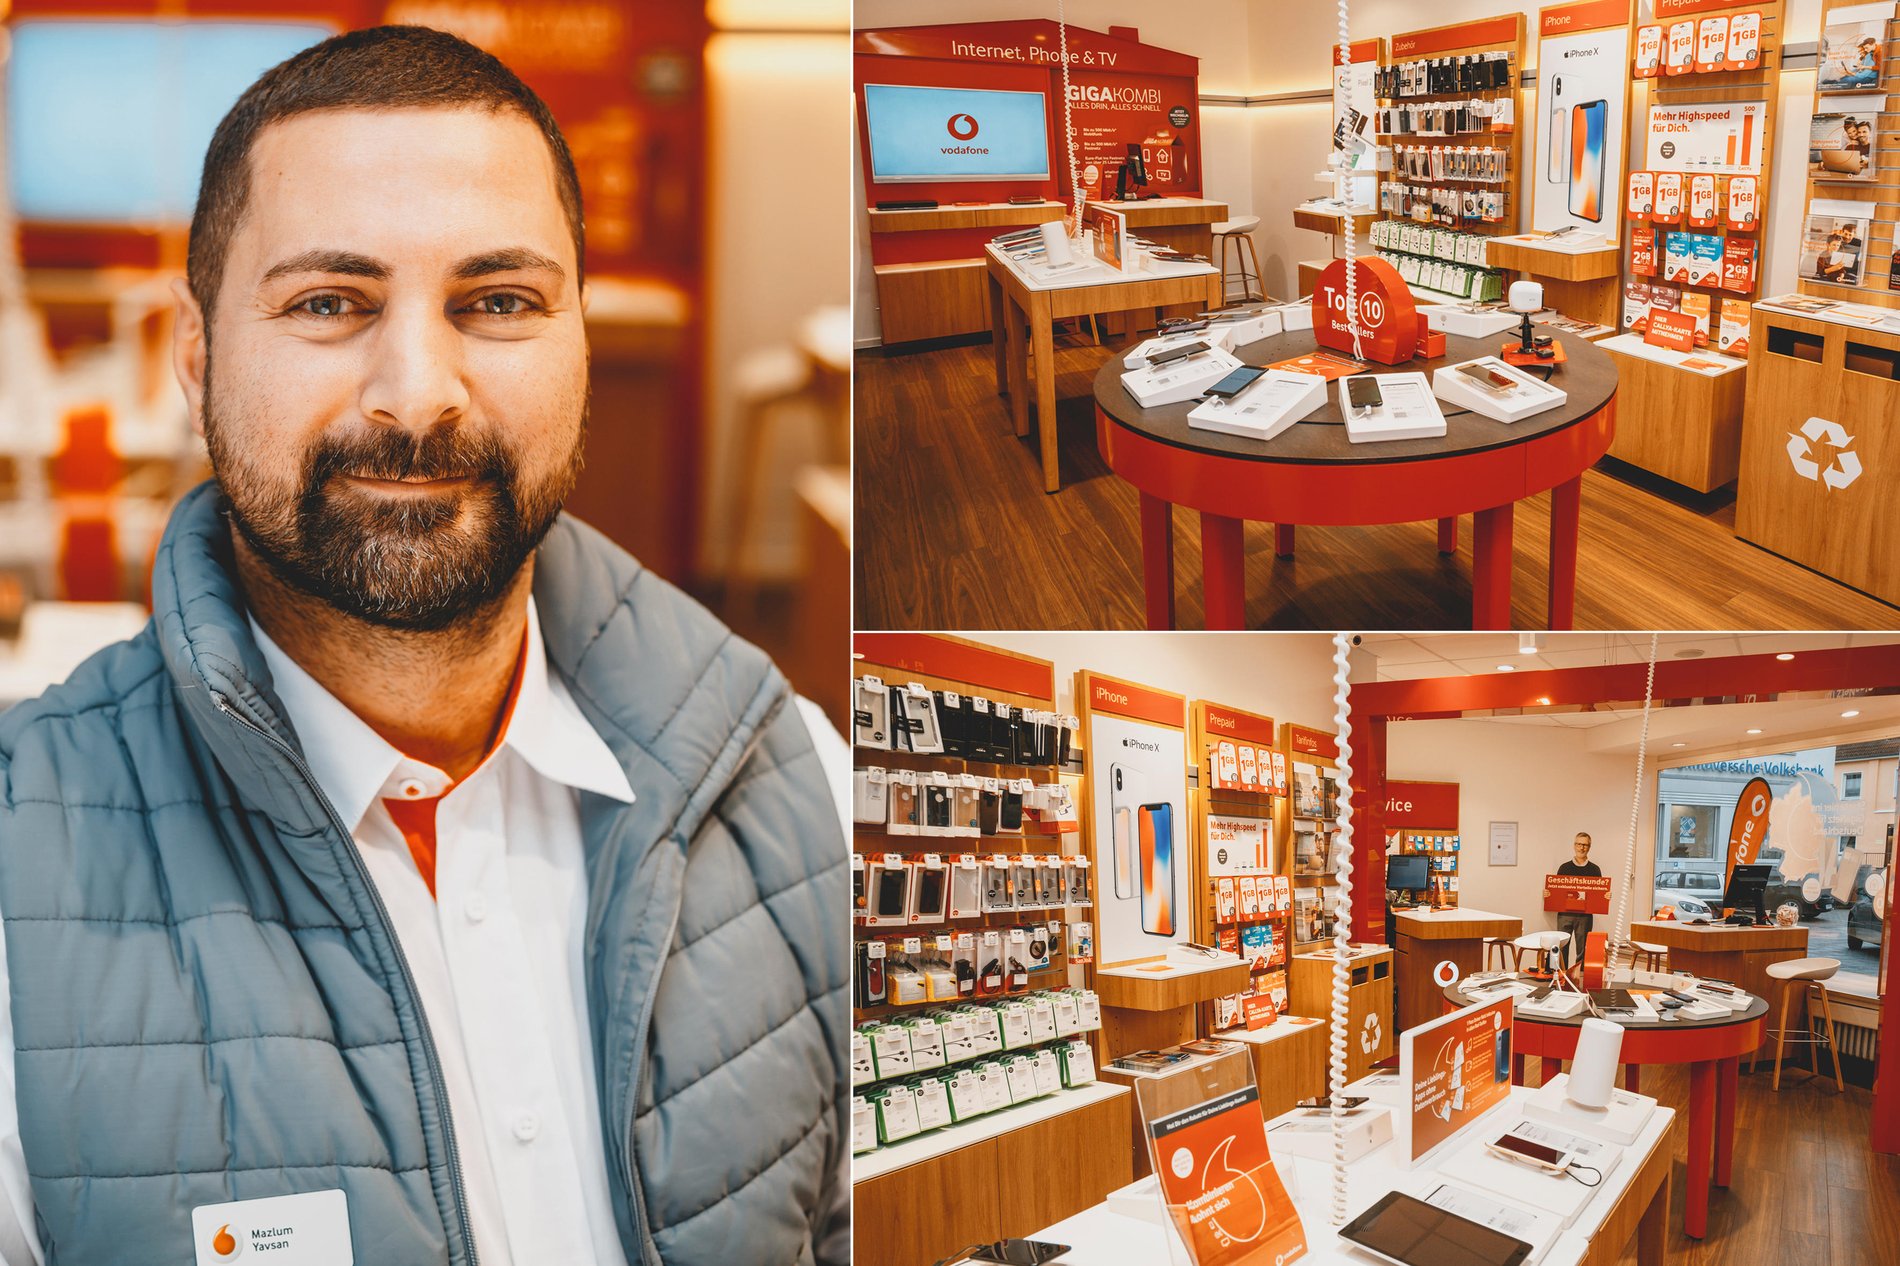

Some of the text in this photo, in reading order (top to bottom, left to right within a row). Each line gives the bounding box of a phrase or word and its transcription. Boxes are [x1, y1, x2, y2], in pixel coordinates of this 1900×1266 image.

[1545, 15, 1571, 27] iPhone
[1672, 36, 1691, 52] 1GB
[1702, 33, 1724, 49] 1GB
[1733, 29, 1757, 46] 1GB
[952, 40, 1117, 66] Internet, Phone & TV
[1395, 41, 1416, 52] Zubehör
[1570, 47, 1599, 58] iPhone X
[1640, 41, 1658, 55] 1GB
[1068, 85, 1161, 104] GIGAKOMBI
[1069, 102, 1090, 110] ALLES
[1111, 103, 1132, 111] ALLES
[1132, 104, 1161, 112] SCHNELL
[1653, 110, 1730, 123] Mehr Highspeed
[1652, 123, 1690, 133] für Dich.
[940, 146, 989, 155] vodafone
[1632, 186, 1651, 200] 1GB
[1659, 188, 1678, 201] 1GB
[1694, 190, 1712, 205] 1GB
[1732, 192, 1753, 207] 1GB
[1633, 251, 1651, 264] 2GB
[1724, 264, 1753, 279] 2GB
[1364, 300, 1381, 320] 10
[1654, 315, 1668, 323] HIER
[1332, 320, 1375, 340] Bestllers
[1096, 687, 1128, 705] iPhone
[1209, 713, 1235, 729] Prepaid
[1129, 738, 1160, 752] iPhone X
[1221, 755, 1235, 768] 1GB
[1241, 759, 1254, 772] 1GB
[1385, 797, 1413, 812] vice
[1210, 820, 1257, 833] Mehr Highspeed
[1210, 831, 1235, 841] für Dich.
[1736, 820, 1754, 866] fone
[1547, 876, 1609, 886] Geschäftskunde?
[1221, 891, 1233, 904] 1GB
[1243, 889, 1255, 902] 1GB
[1258, 888, 1273, 901] 1GB
[1275, 888, 1289, 900] 1GB
[1186, 1182, 1235, 1211] Kombinieren
[1215, 1199, 1231, 1215] sich
[251, 1226, 293, 1239] Mazlum
[252, 1239, 289, 1252] Yavsan
